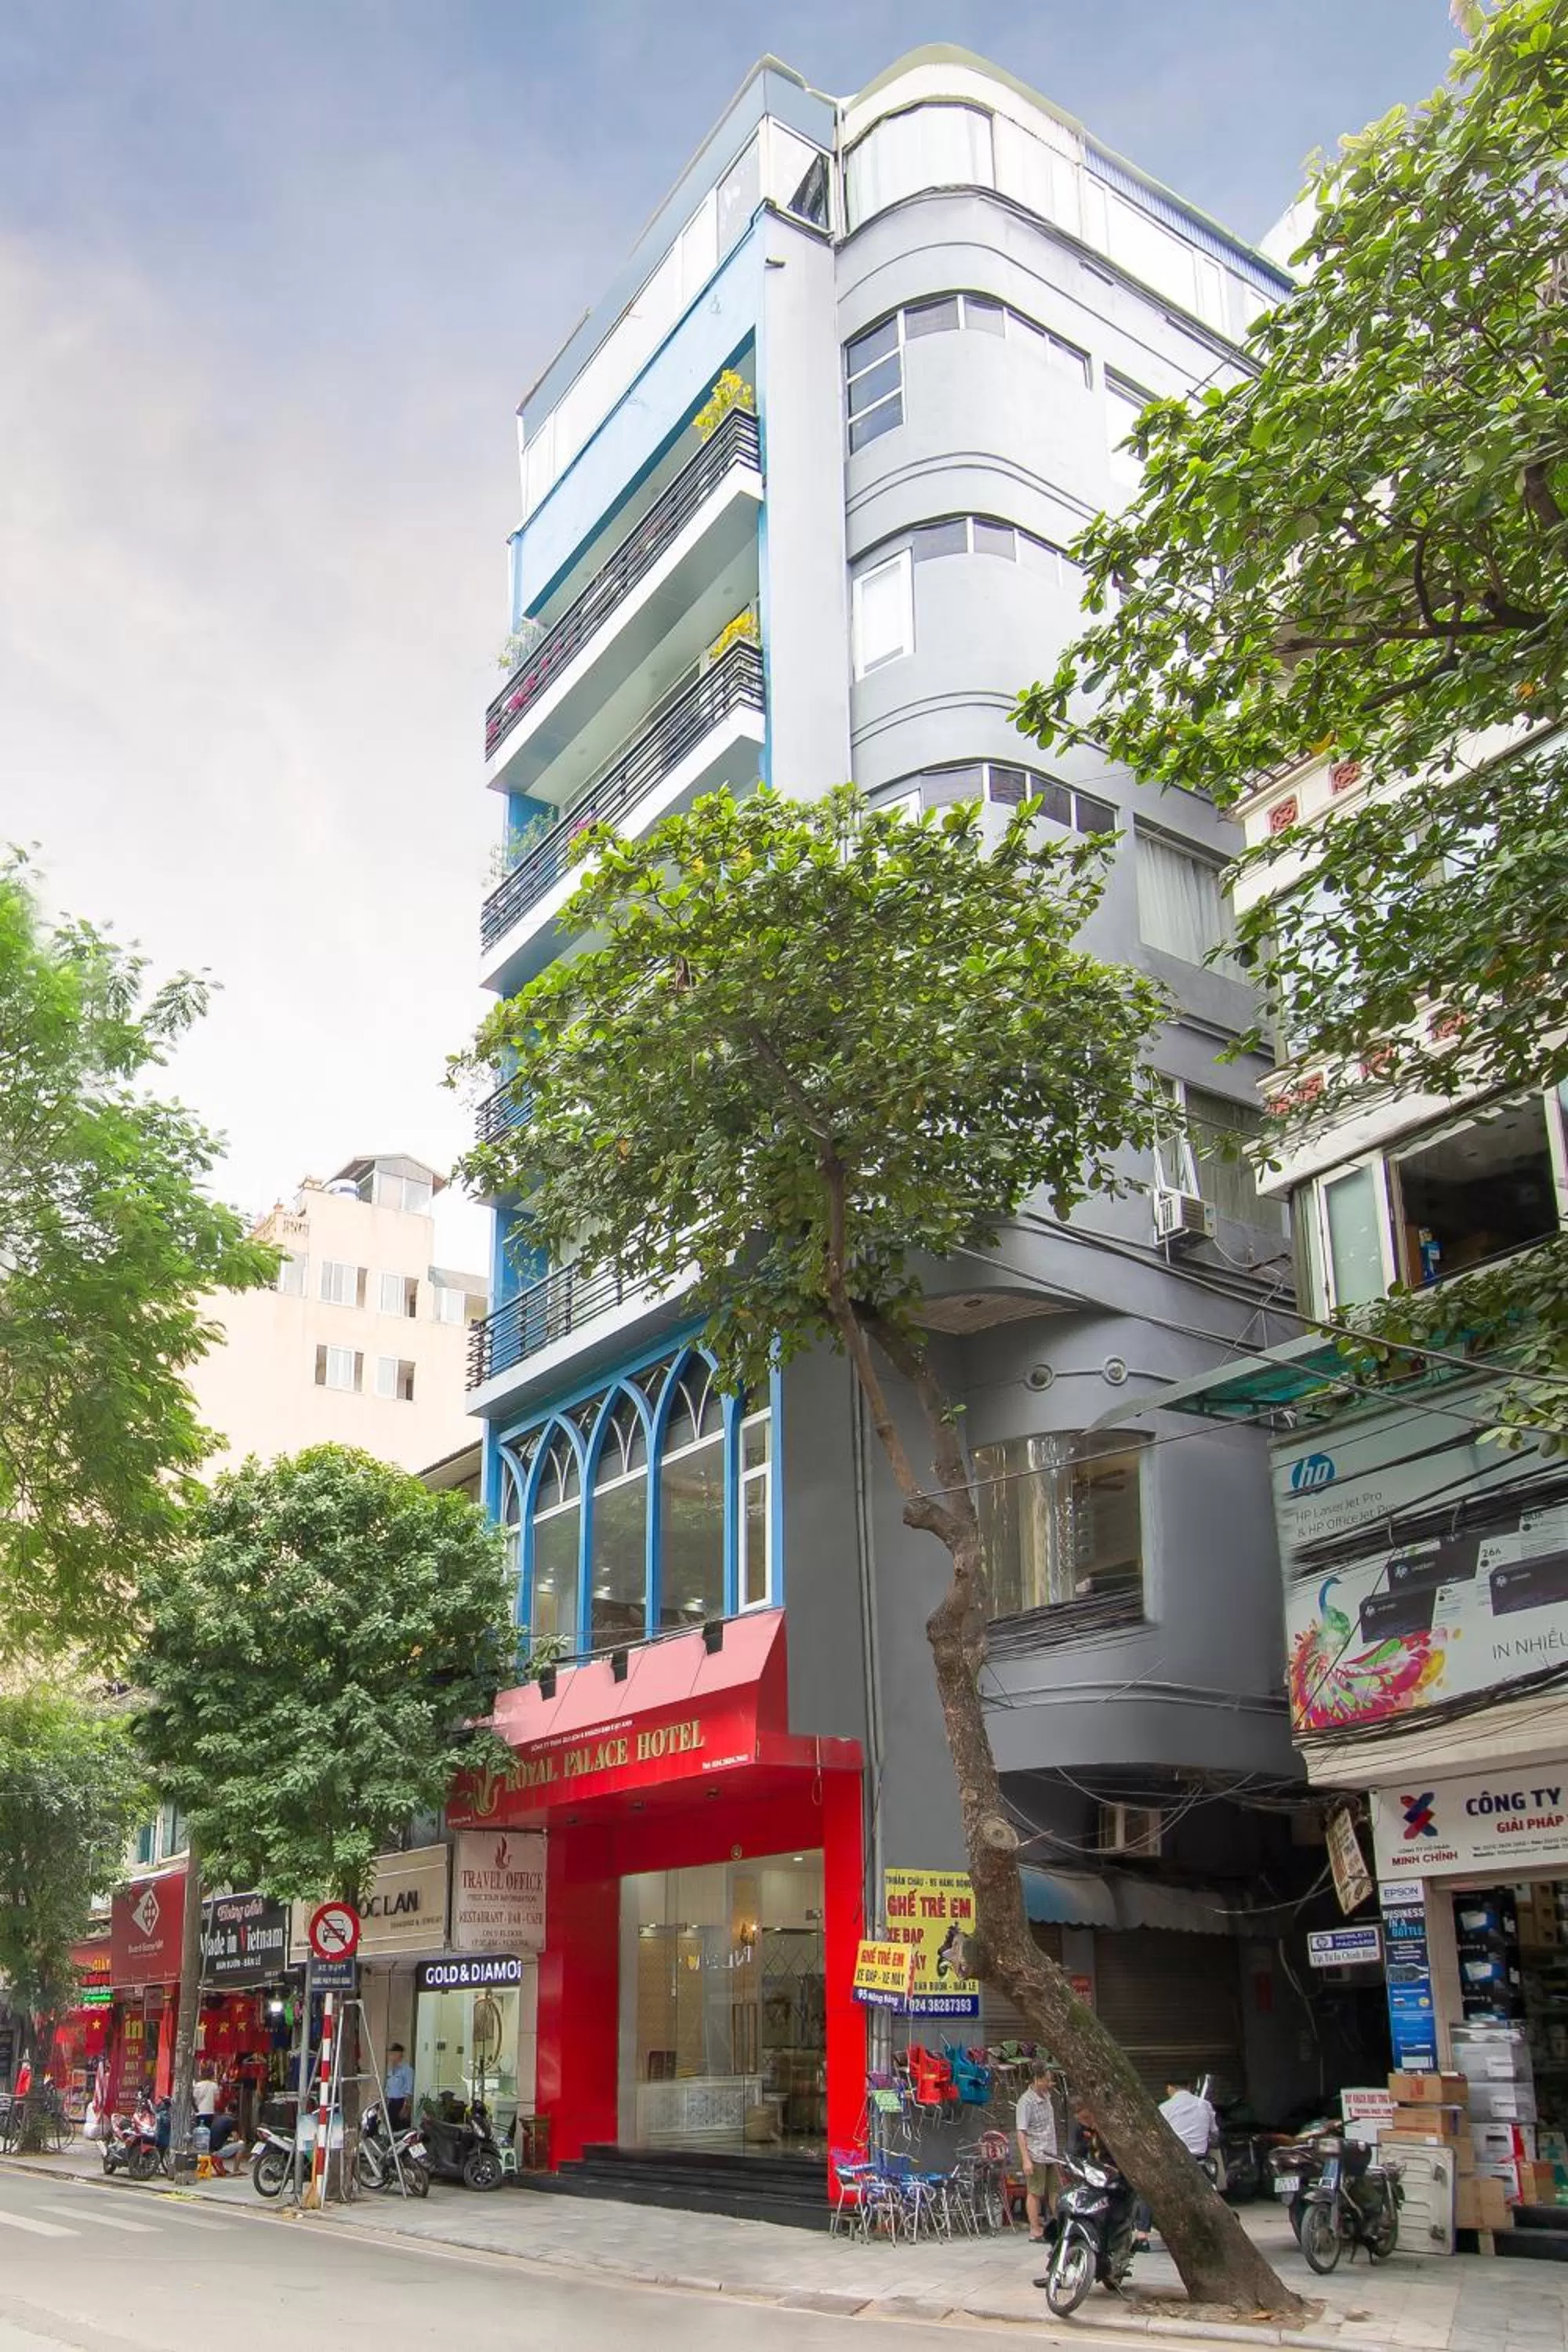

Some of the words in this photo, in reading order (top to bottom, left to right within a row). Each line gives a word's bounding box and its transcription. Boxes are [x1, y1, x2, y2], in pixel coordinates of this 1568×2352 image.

[1296, 1510, 1312, 1523] HP
[1363, 1492, 1382, 1503] Pro
[1308, 1523, 1324, 1535] HP
[1493, 1643, 1510, 1660] IN
[505, 1757, 558, 1792] ROYAL
[564, 1737, 628, 1777] PALACE
[637, 1719, 705, 1761] HOTEL
[1465, 1790, 1526, 1817] CÔNG
[1530, 1787, 1561, 1807] TY
[1497, 1817, 1523, 1833] GIẢI
[1527, 1812, 1564, 1830] PHÁP
[1392, 1855, 1420, 1867] MINH
[1423, 1850, 1458, 1864] CHÍNH
[461, 1870, 504, 1889] TRAVEL
[506, 1871, 543, 1891] OFFICE
[1384, 1886, 1418, 1898] EPSON
[383, 1889, 419, 1916] LAN
[887, 1889, 917, 1917] GHẾ
[920, 1891, 946, 1918] TRẺ
[950, 1897, 971, 1918] EM
[1382, 1907, 1425, 1920] BUSINESS
[1388, 1919, 1398, 1928] IN
[227, 1927, 238, 1955] in
[238, 1925, 283, 1953] Vietnam
[887, 1927, 901, 1942] XE
[860, 1947, 877, 1964] GHẾ
[877, 1947, 891, 1965] TRẺ
[892, 1952, 905, 1967] EM
[912, 1951, 927, 1970] ÁY
[426, 1965, 459, 1984] GOLD
[459, 1963, 470, 1983] &
[909, 1998, 926, 2013] 024
